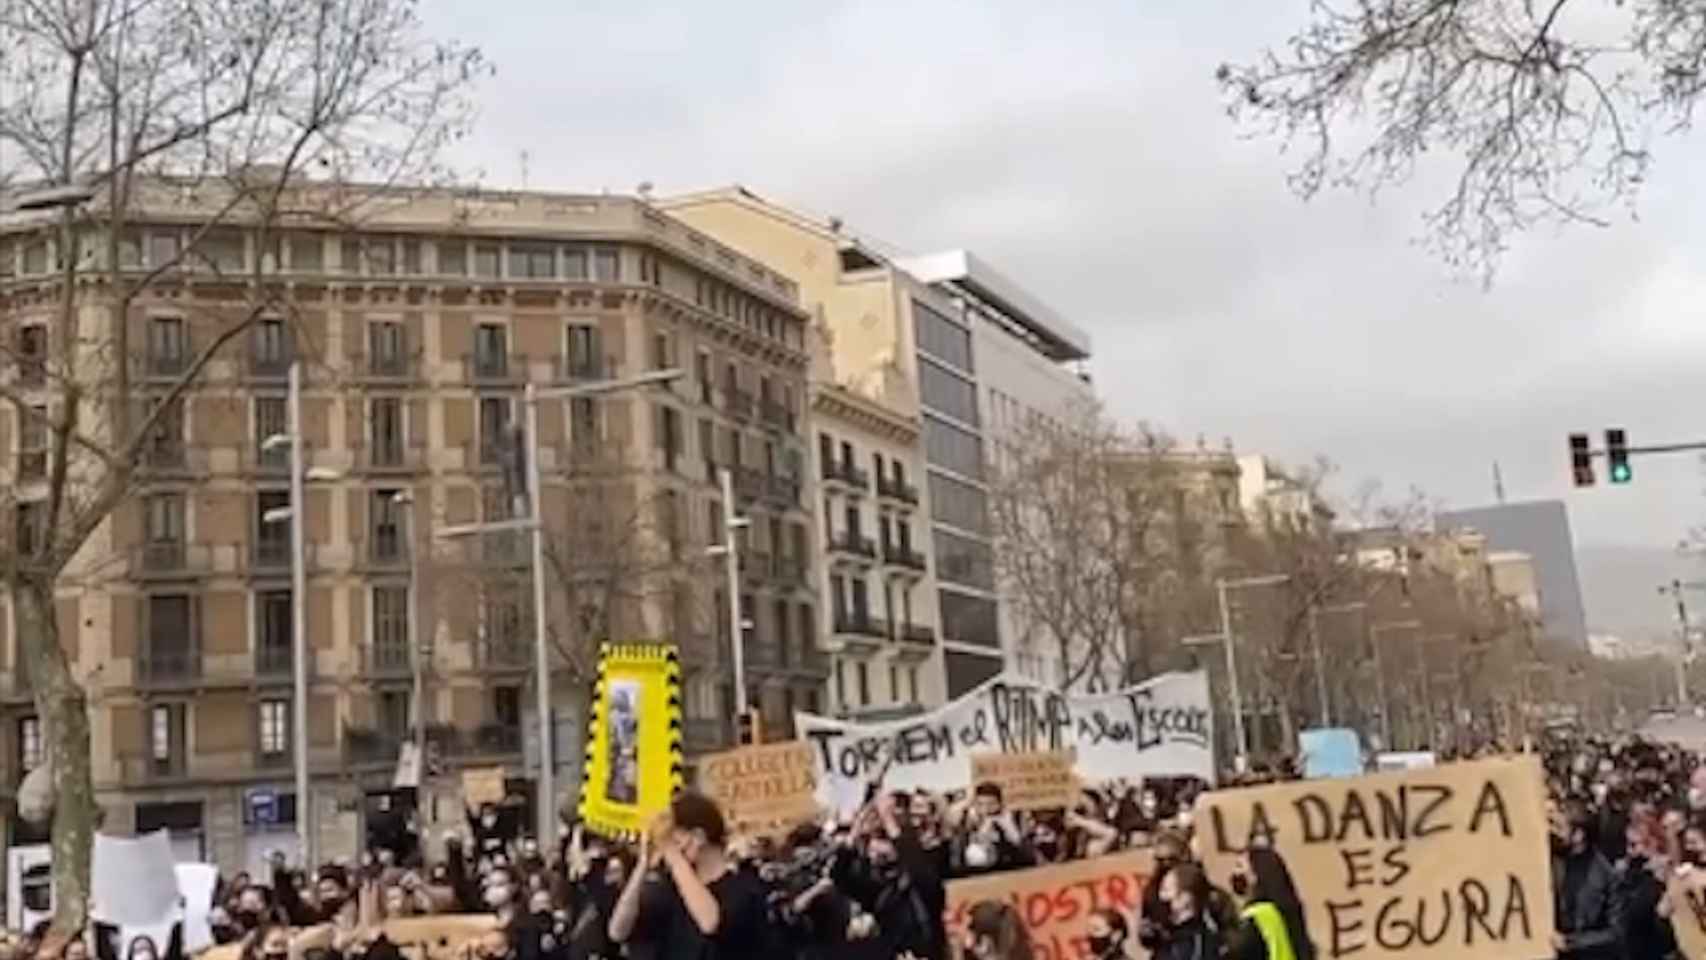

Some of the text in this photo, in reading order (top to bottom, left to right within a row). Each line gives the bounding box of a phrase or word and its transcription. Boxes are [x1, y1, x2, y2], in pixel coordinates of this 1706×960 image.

[1210, 780, 1512, 854] LA DANZA
[1341, 846, 1411, 889] ES
[1325, 874, 1532, 958] EGURA
